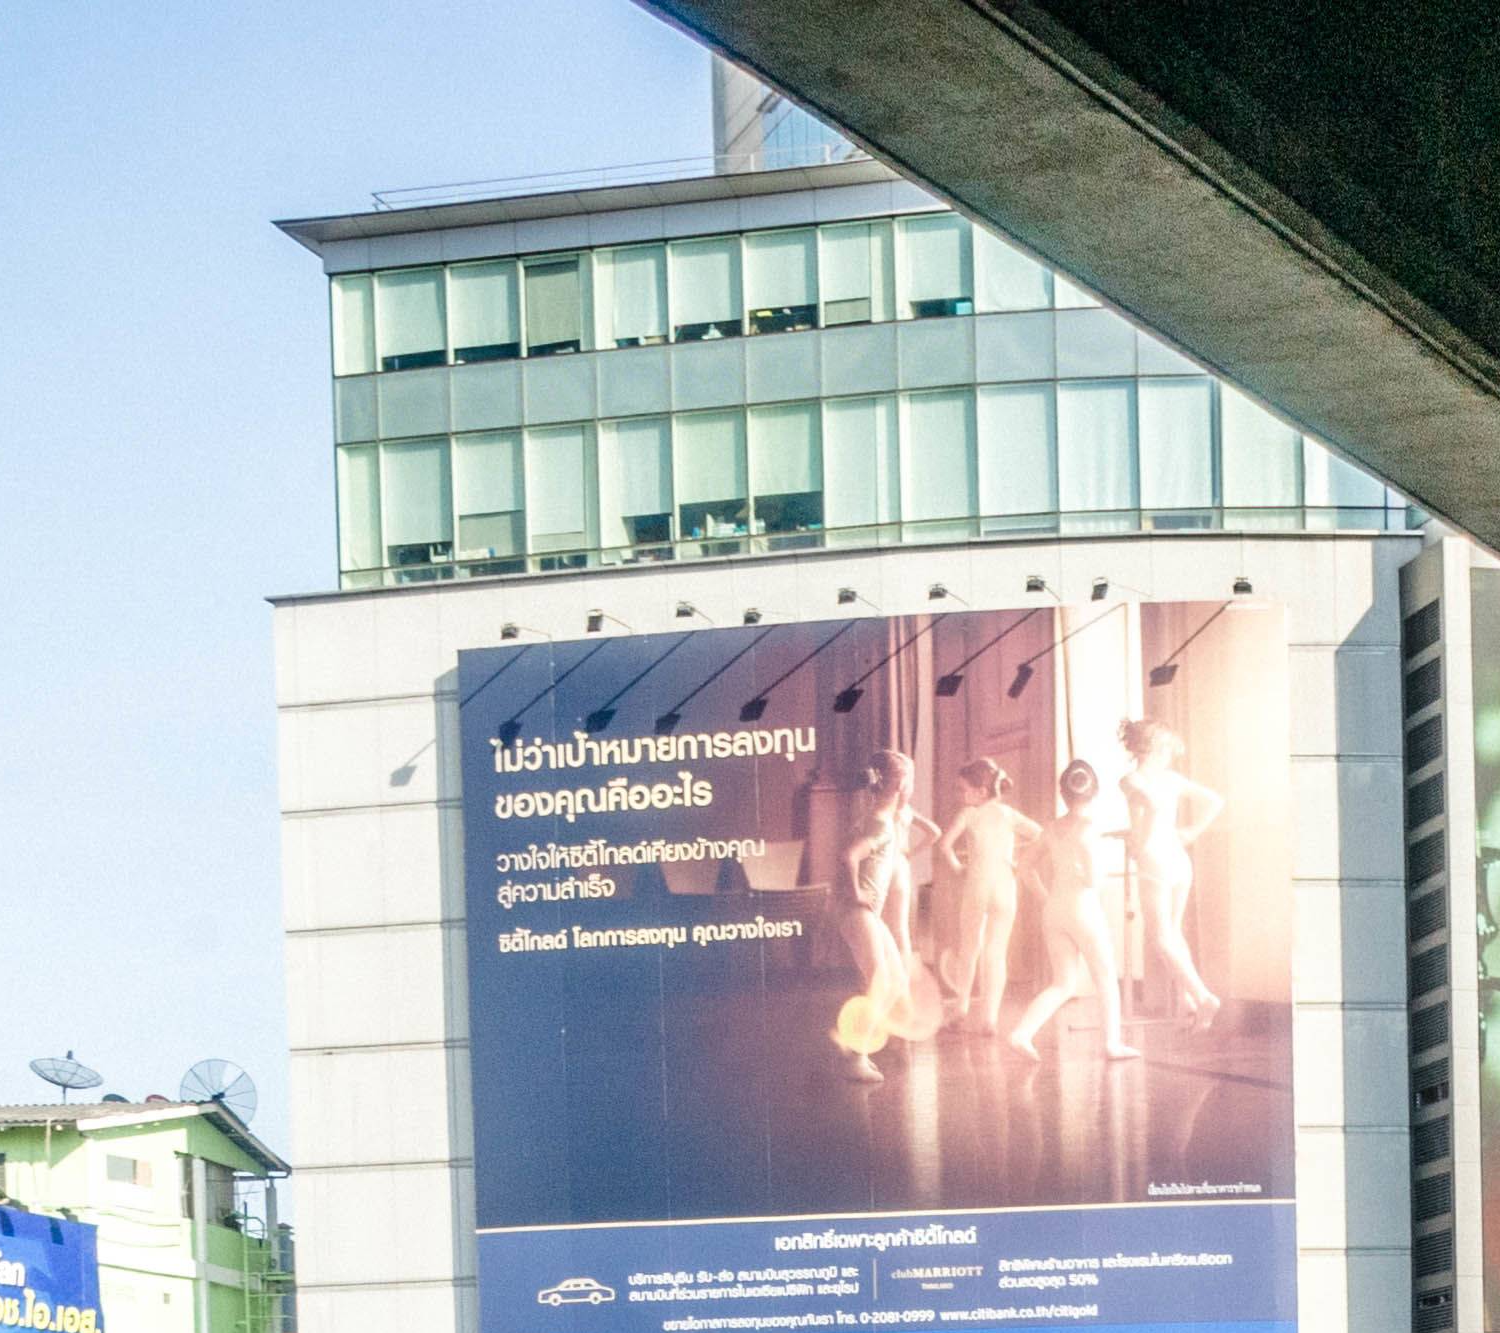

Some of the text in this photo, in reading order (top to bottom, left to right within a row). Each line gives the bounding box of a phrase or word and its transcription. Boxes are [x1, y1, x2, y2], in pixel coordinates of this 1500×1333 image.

[489, 727, 816, 773] ไม่ว่าเป้าหมายการลงทุน
[495, 771, 713, 822] ของคุณคืออะไร
[496, 837, 766, 872] วางใจให้ซิตี้โกลด์เคียงข้างคุณ
[497, 873, 616, 909] สู่ความสำเร็จ
[499, 916, 803, 953] ซิตี้โกลด์ โลกการลงทุน คุณวางใจเรา
[775, 1223, 978, 1251] เอกสิทธิ์เฉพาะลูกค้าซิตี้โกลด์
[1069, 1273, 1098, 1286] 50%
[860, 1309, 935, 1324] 0-2081-0999
[940, 1303, 1098, 1321] www.citibank.co.th/citigold
